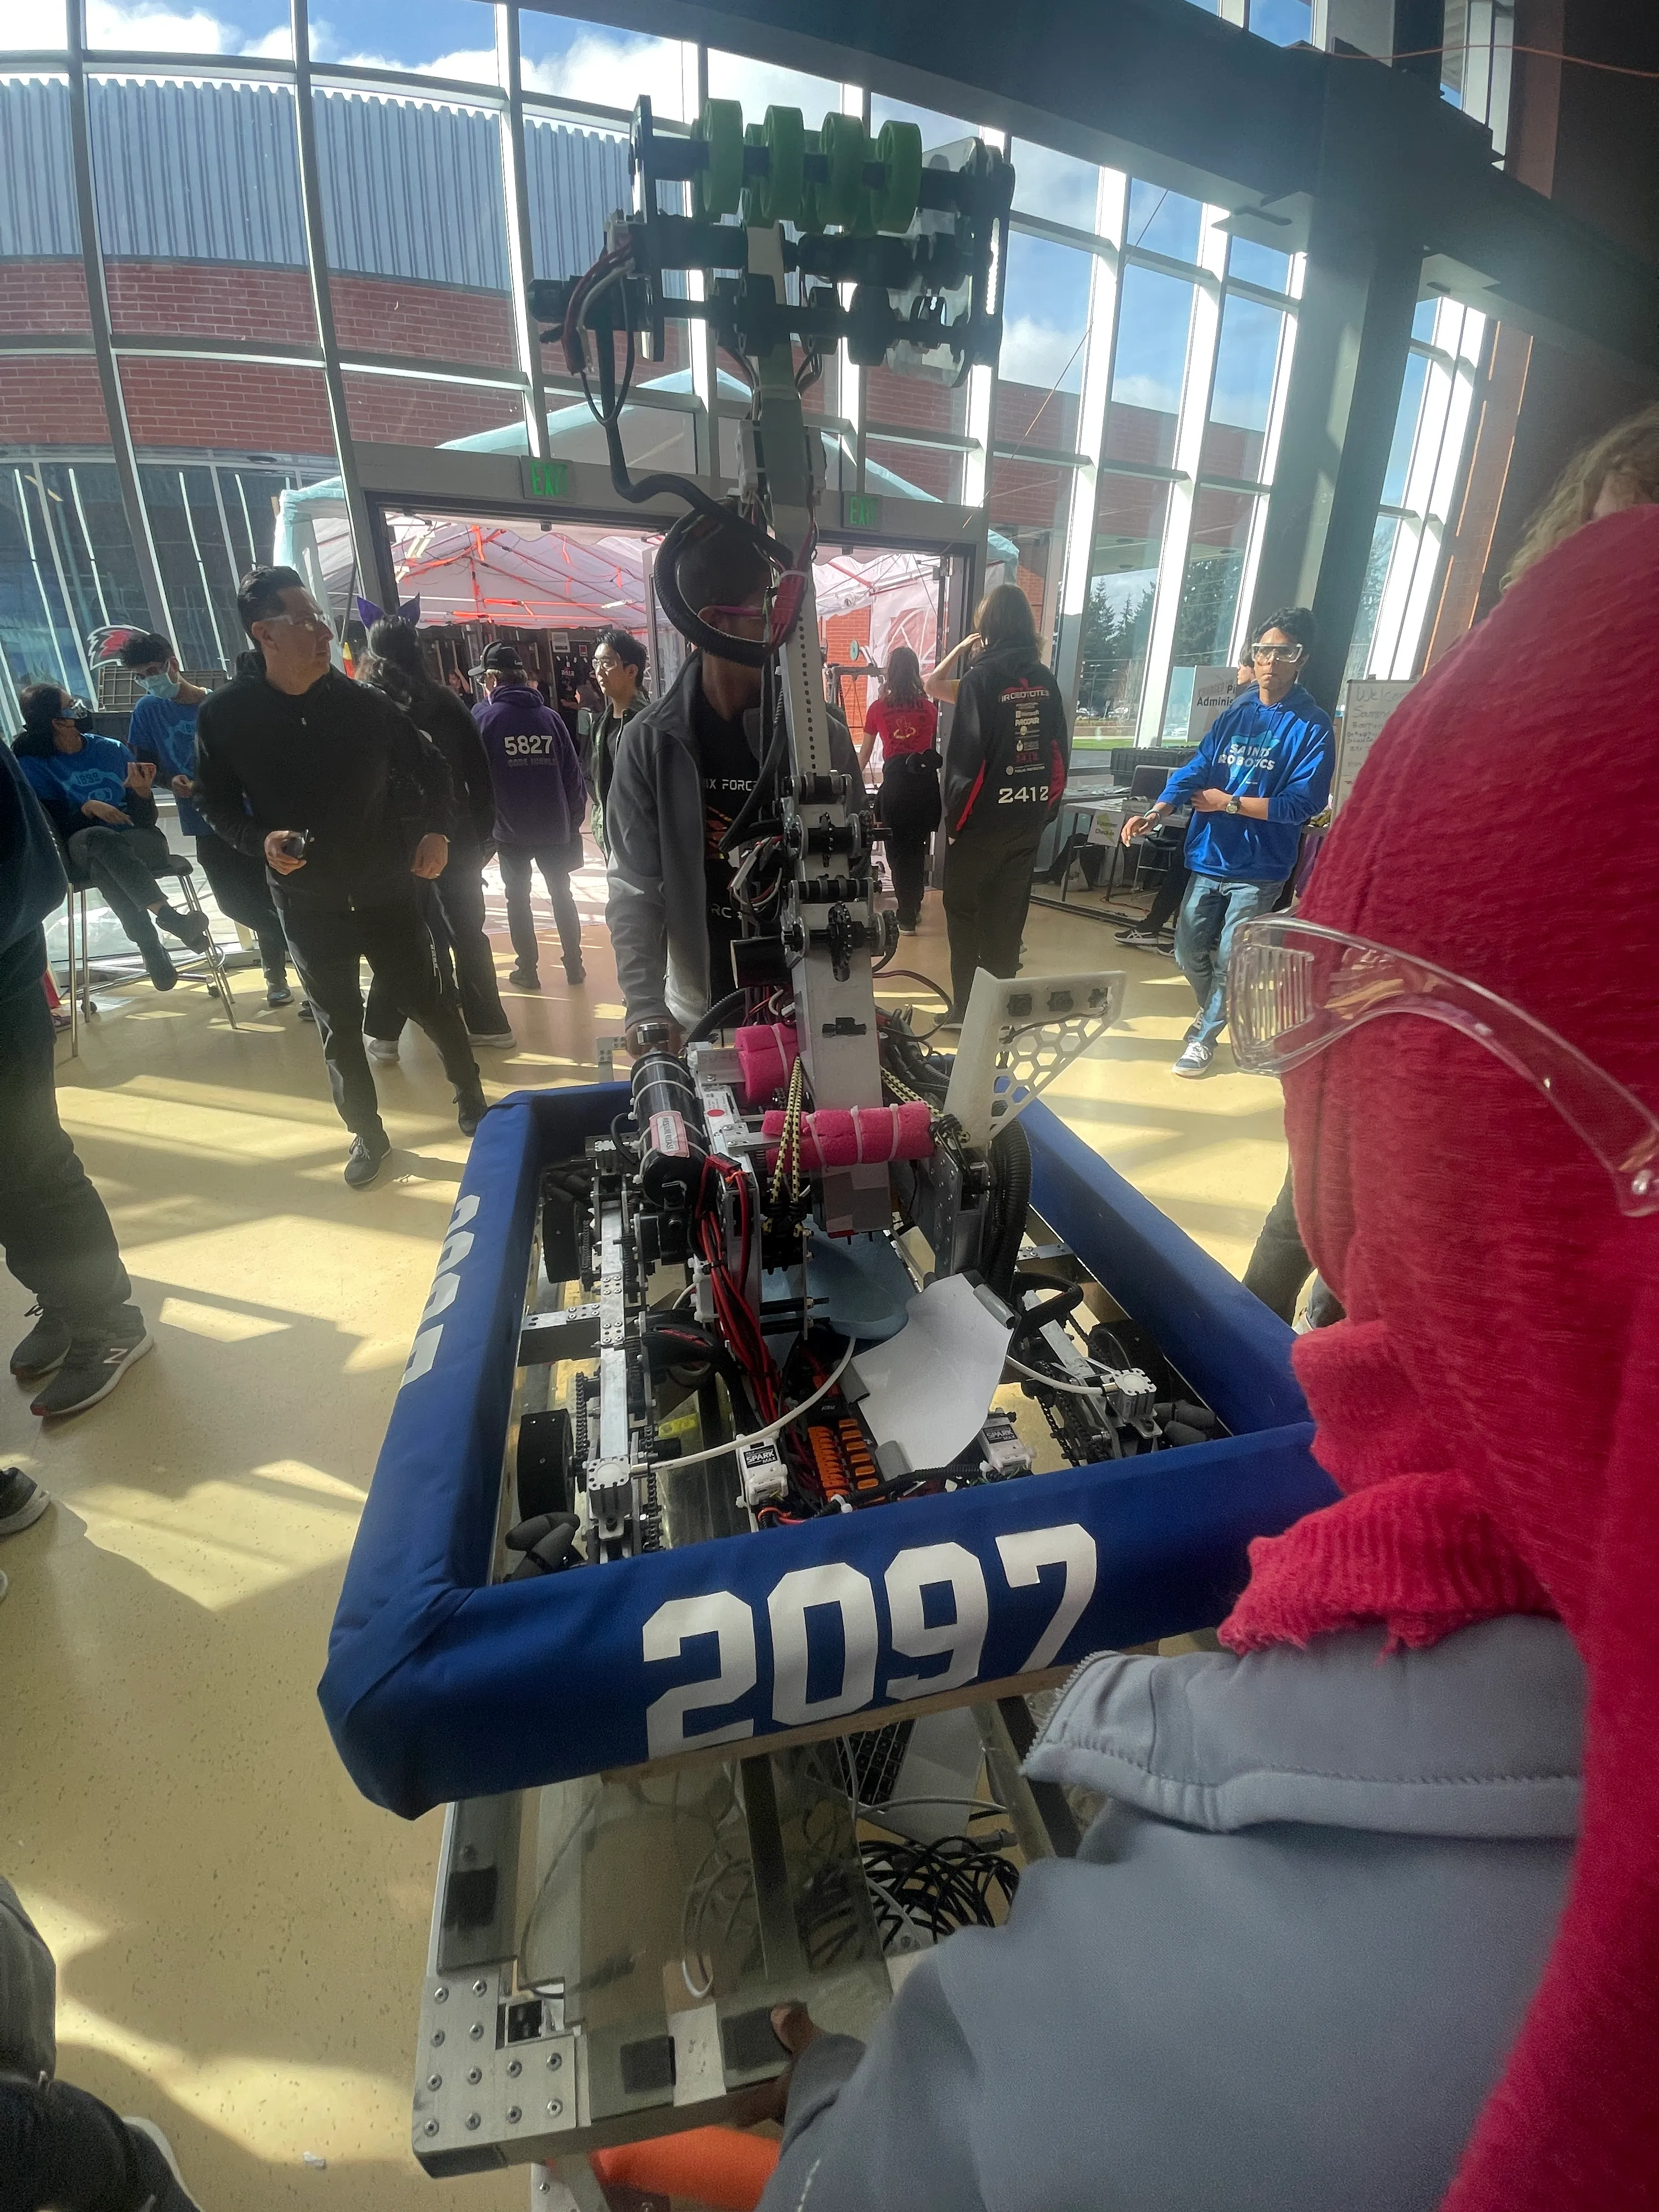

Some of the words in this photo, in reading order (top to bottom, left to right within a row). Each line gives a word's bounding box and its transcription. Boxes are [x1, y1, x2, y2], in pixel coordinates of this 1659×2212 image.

[531, 461, 567, 496] EXIT
[849, 496, 877, 527] EXIT
[1227, 684, 1236, 694] Pi
[1197, 696, 1234, 707] Adminis
[504, 735, 552, 755] 5827
[722, 779, 758, 791] FORC
[998, 786, 1049, 804] 2412
[986, 1429, 1014, 1438] SPARK
[746, 1450, 775, 1463] SPARK
[642, 1523, 1097, 1759] 2097
